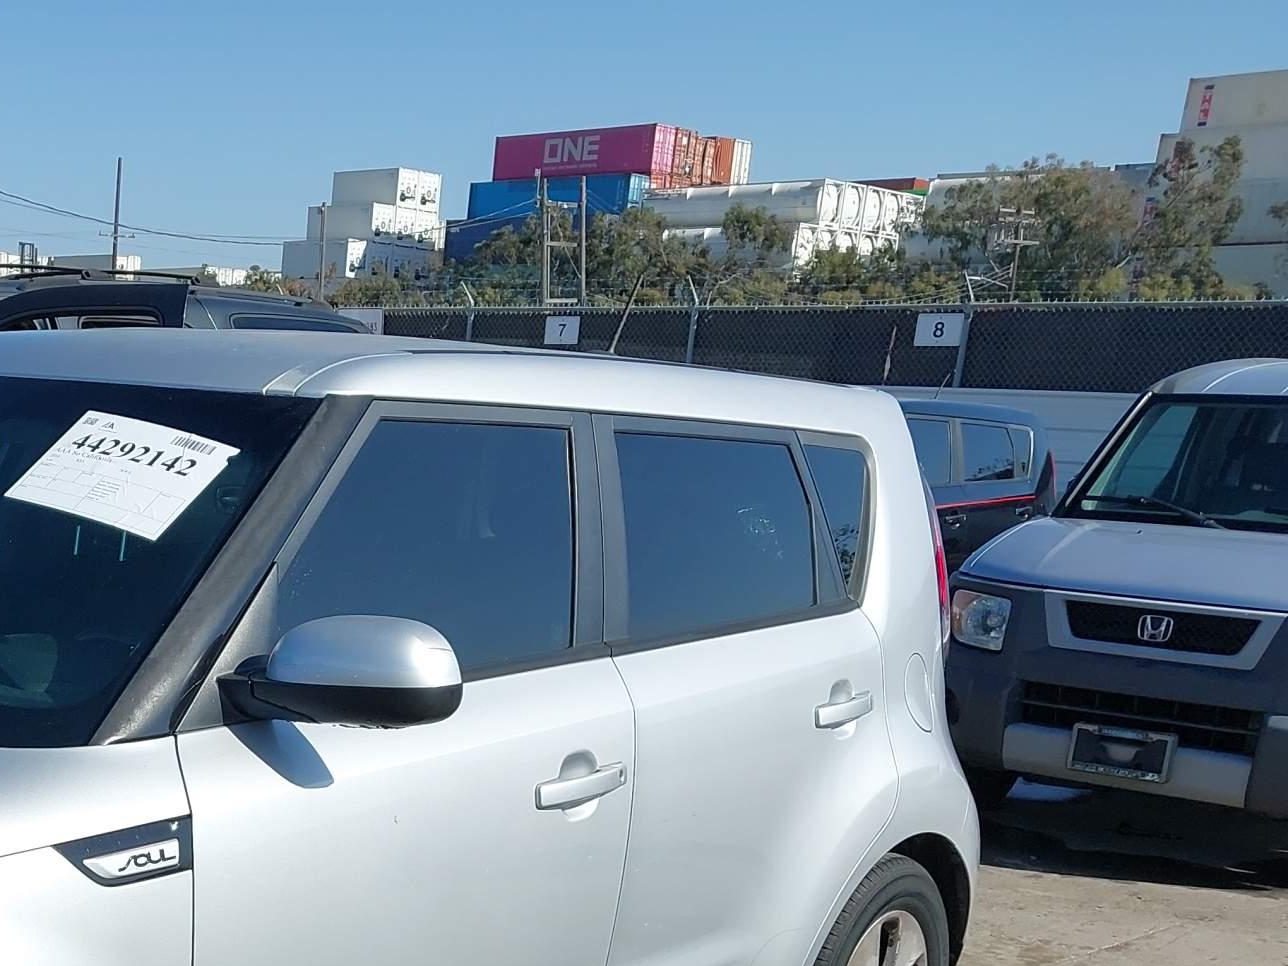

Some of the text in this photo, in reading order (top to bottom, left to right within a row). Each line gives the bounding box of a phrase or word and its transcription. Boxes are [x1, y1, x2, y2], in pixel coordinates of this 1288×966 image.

[543, 135, 600, 163] ONE
[558, 323, 567, 337] 7
[933, 321, 945, 338] 8
[72, 433, 197, 476] 44292142
